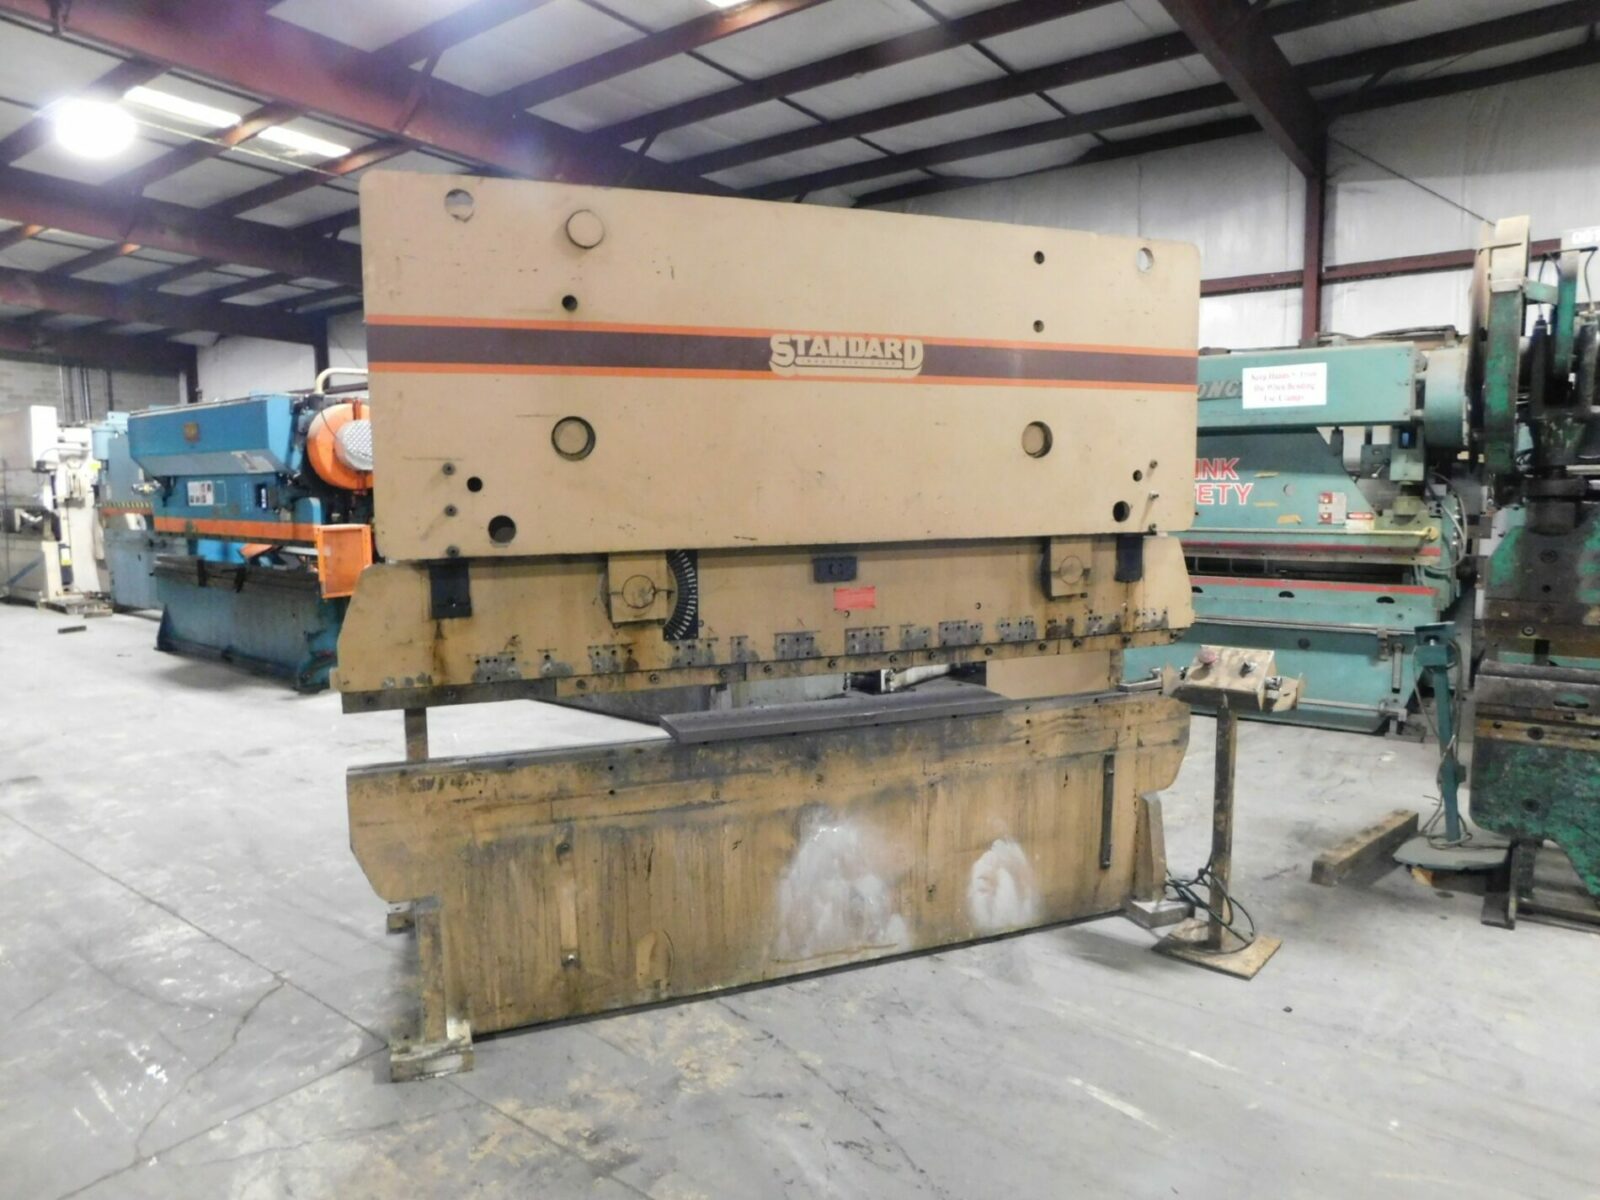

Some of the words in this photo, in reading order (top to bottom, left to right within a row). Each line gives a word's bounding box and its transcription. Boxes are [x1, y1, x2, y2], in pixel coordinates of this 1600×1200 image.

[769, 333, 924, 371] STANDARD
[1195, 458, 1240, 480] INK
[1195, 483, 1255, 506] ETY
